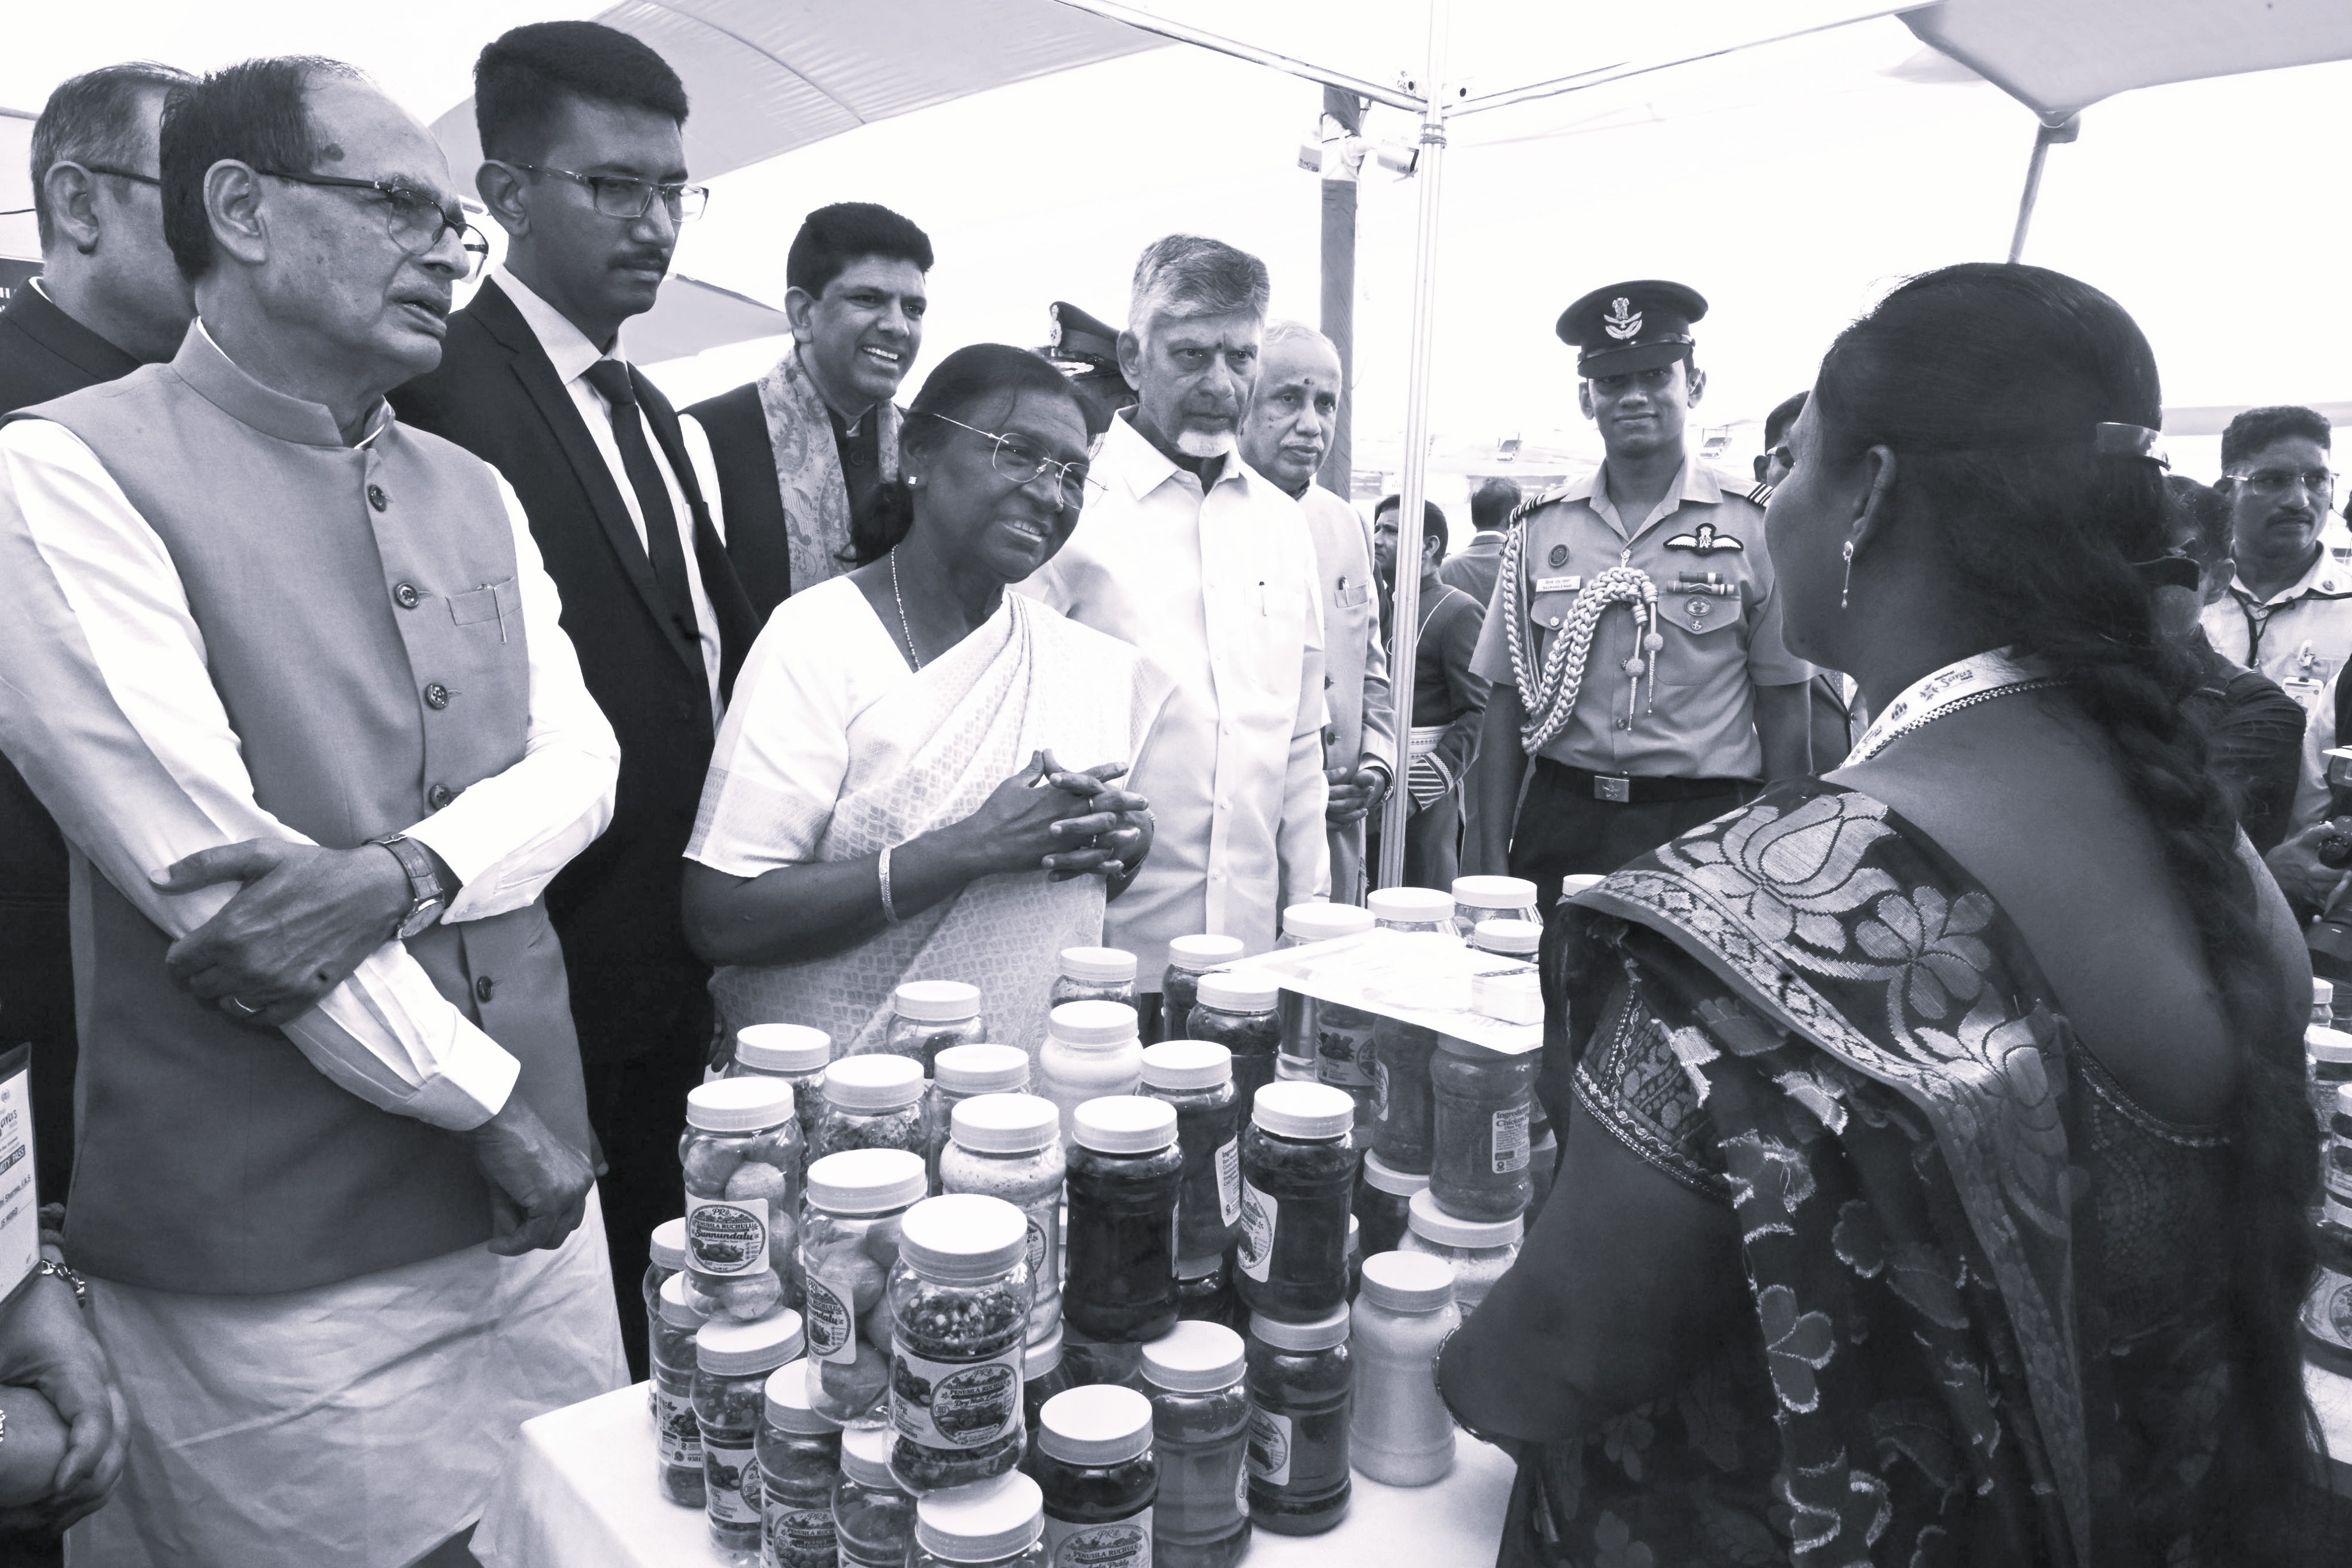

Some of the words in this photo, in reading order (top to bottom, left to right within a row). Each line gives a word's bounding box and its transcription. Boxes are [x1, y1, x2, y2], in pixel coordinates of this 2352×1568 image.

[1699, 540, 1711, 548] IAF
[1940, 670, 1972, 688] Saras
[695, 1229, 753, 1240] Sunnundalu
[1073, 1551, 1107, 1559] PENUSILA
[1108, 1543, 1139, 1557] RUCHULU
